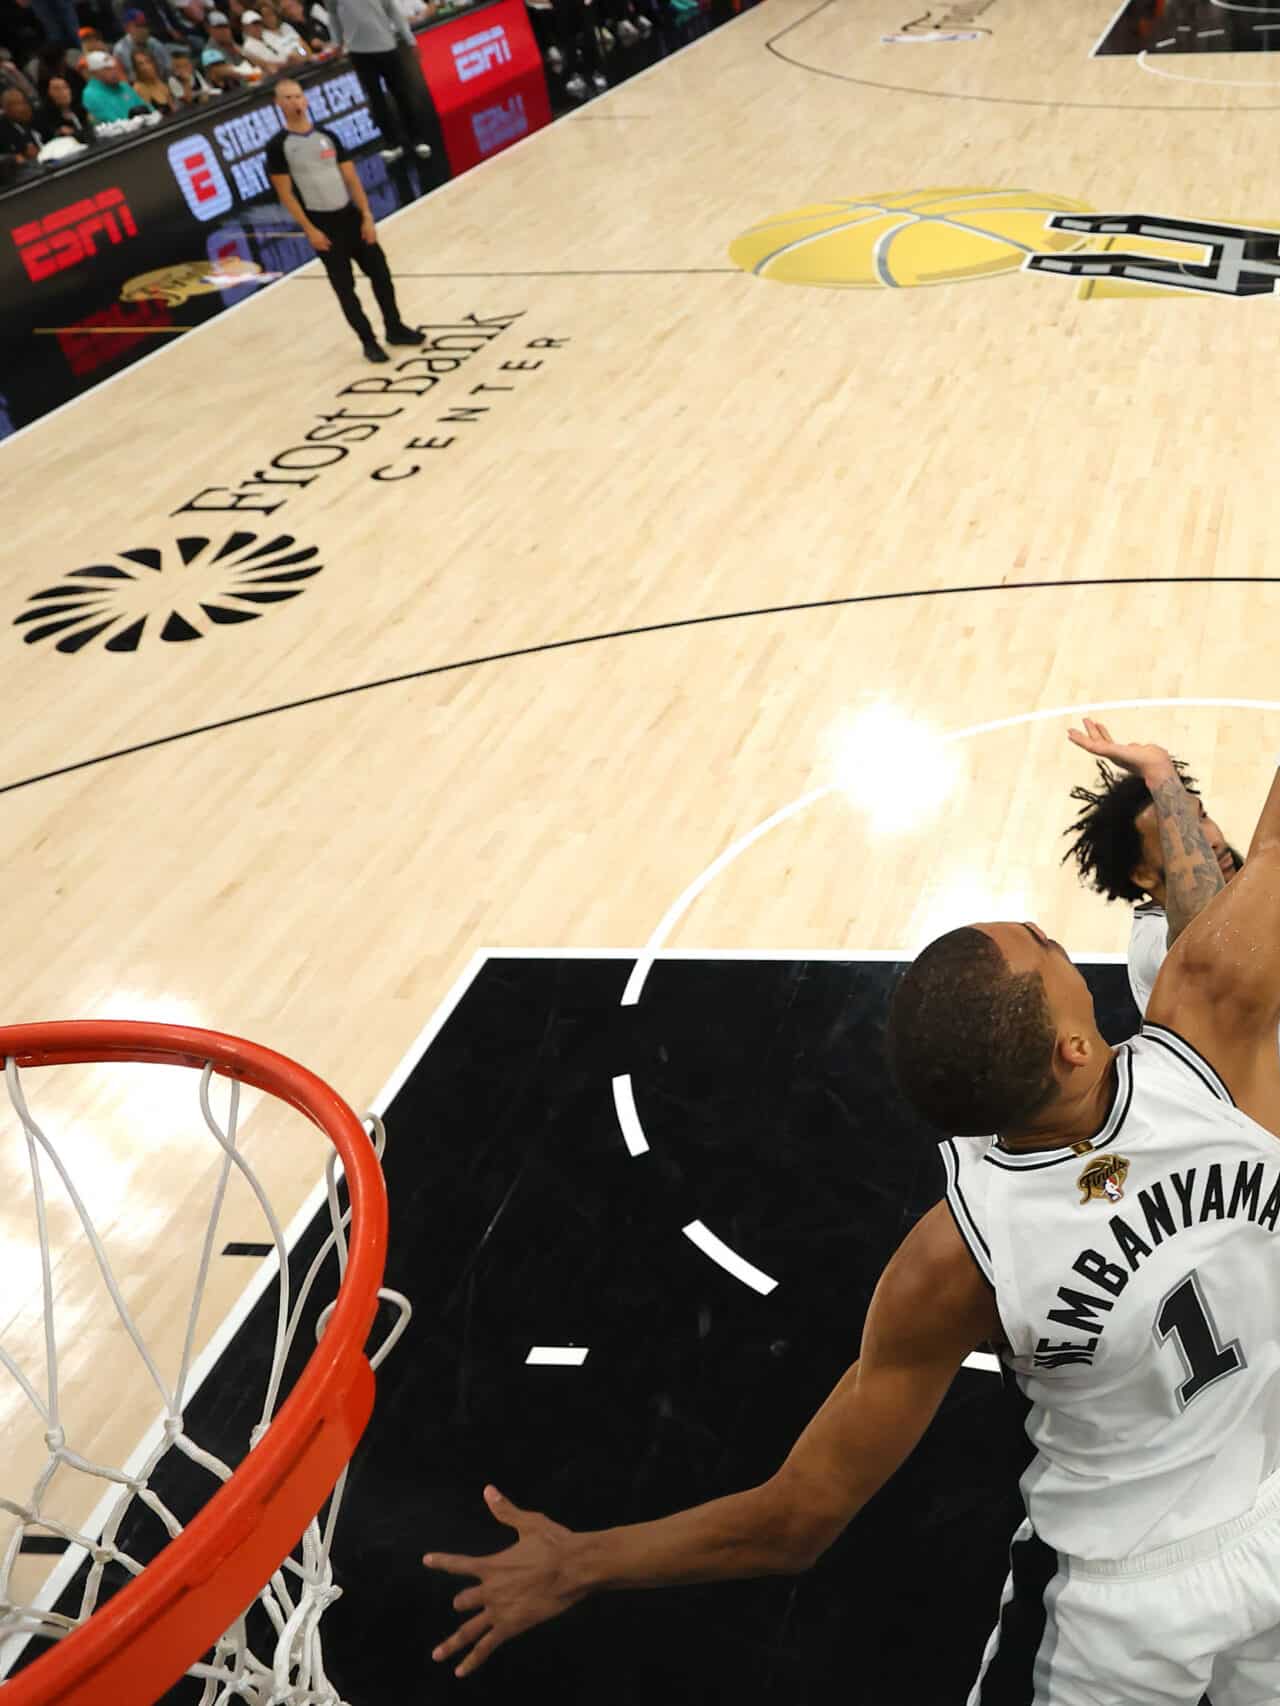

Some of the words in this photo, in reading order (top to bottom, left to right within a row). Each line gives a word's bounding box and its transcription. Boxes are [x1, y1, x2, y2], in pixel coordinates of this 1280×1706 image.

[451, 25, 512, 83] ESPN
[10, 186, 138, 283] ESPN
[169, 408, 404, 517] Frost
[336, 311, 528, 397] Bank
[371, 336, 571, 482] CENTER
[1151, 1268, 1248, 1413] 1
